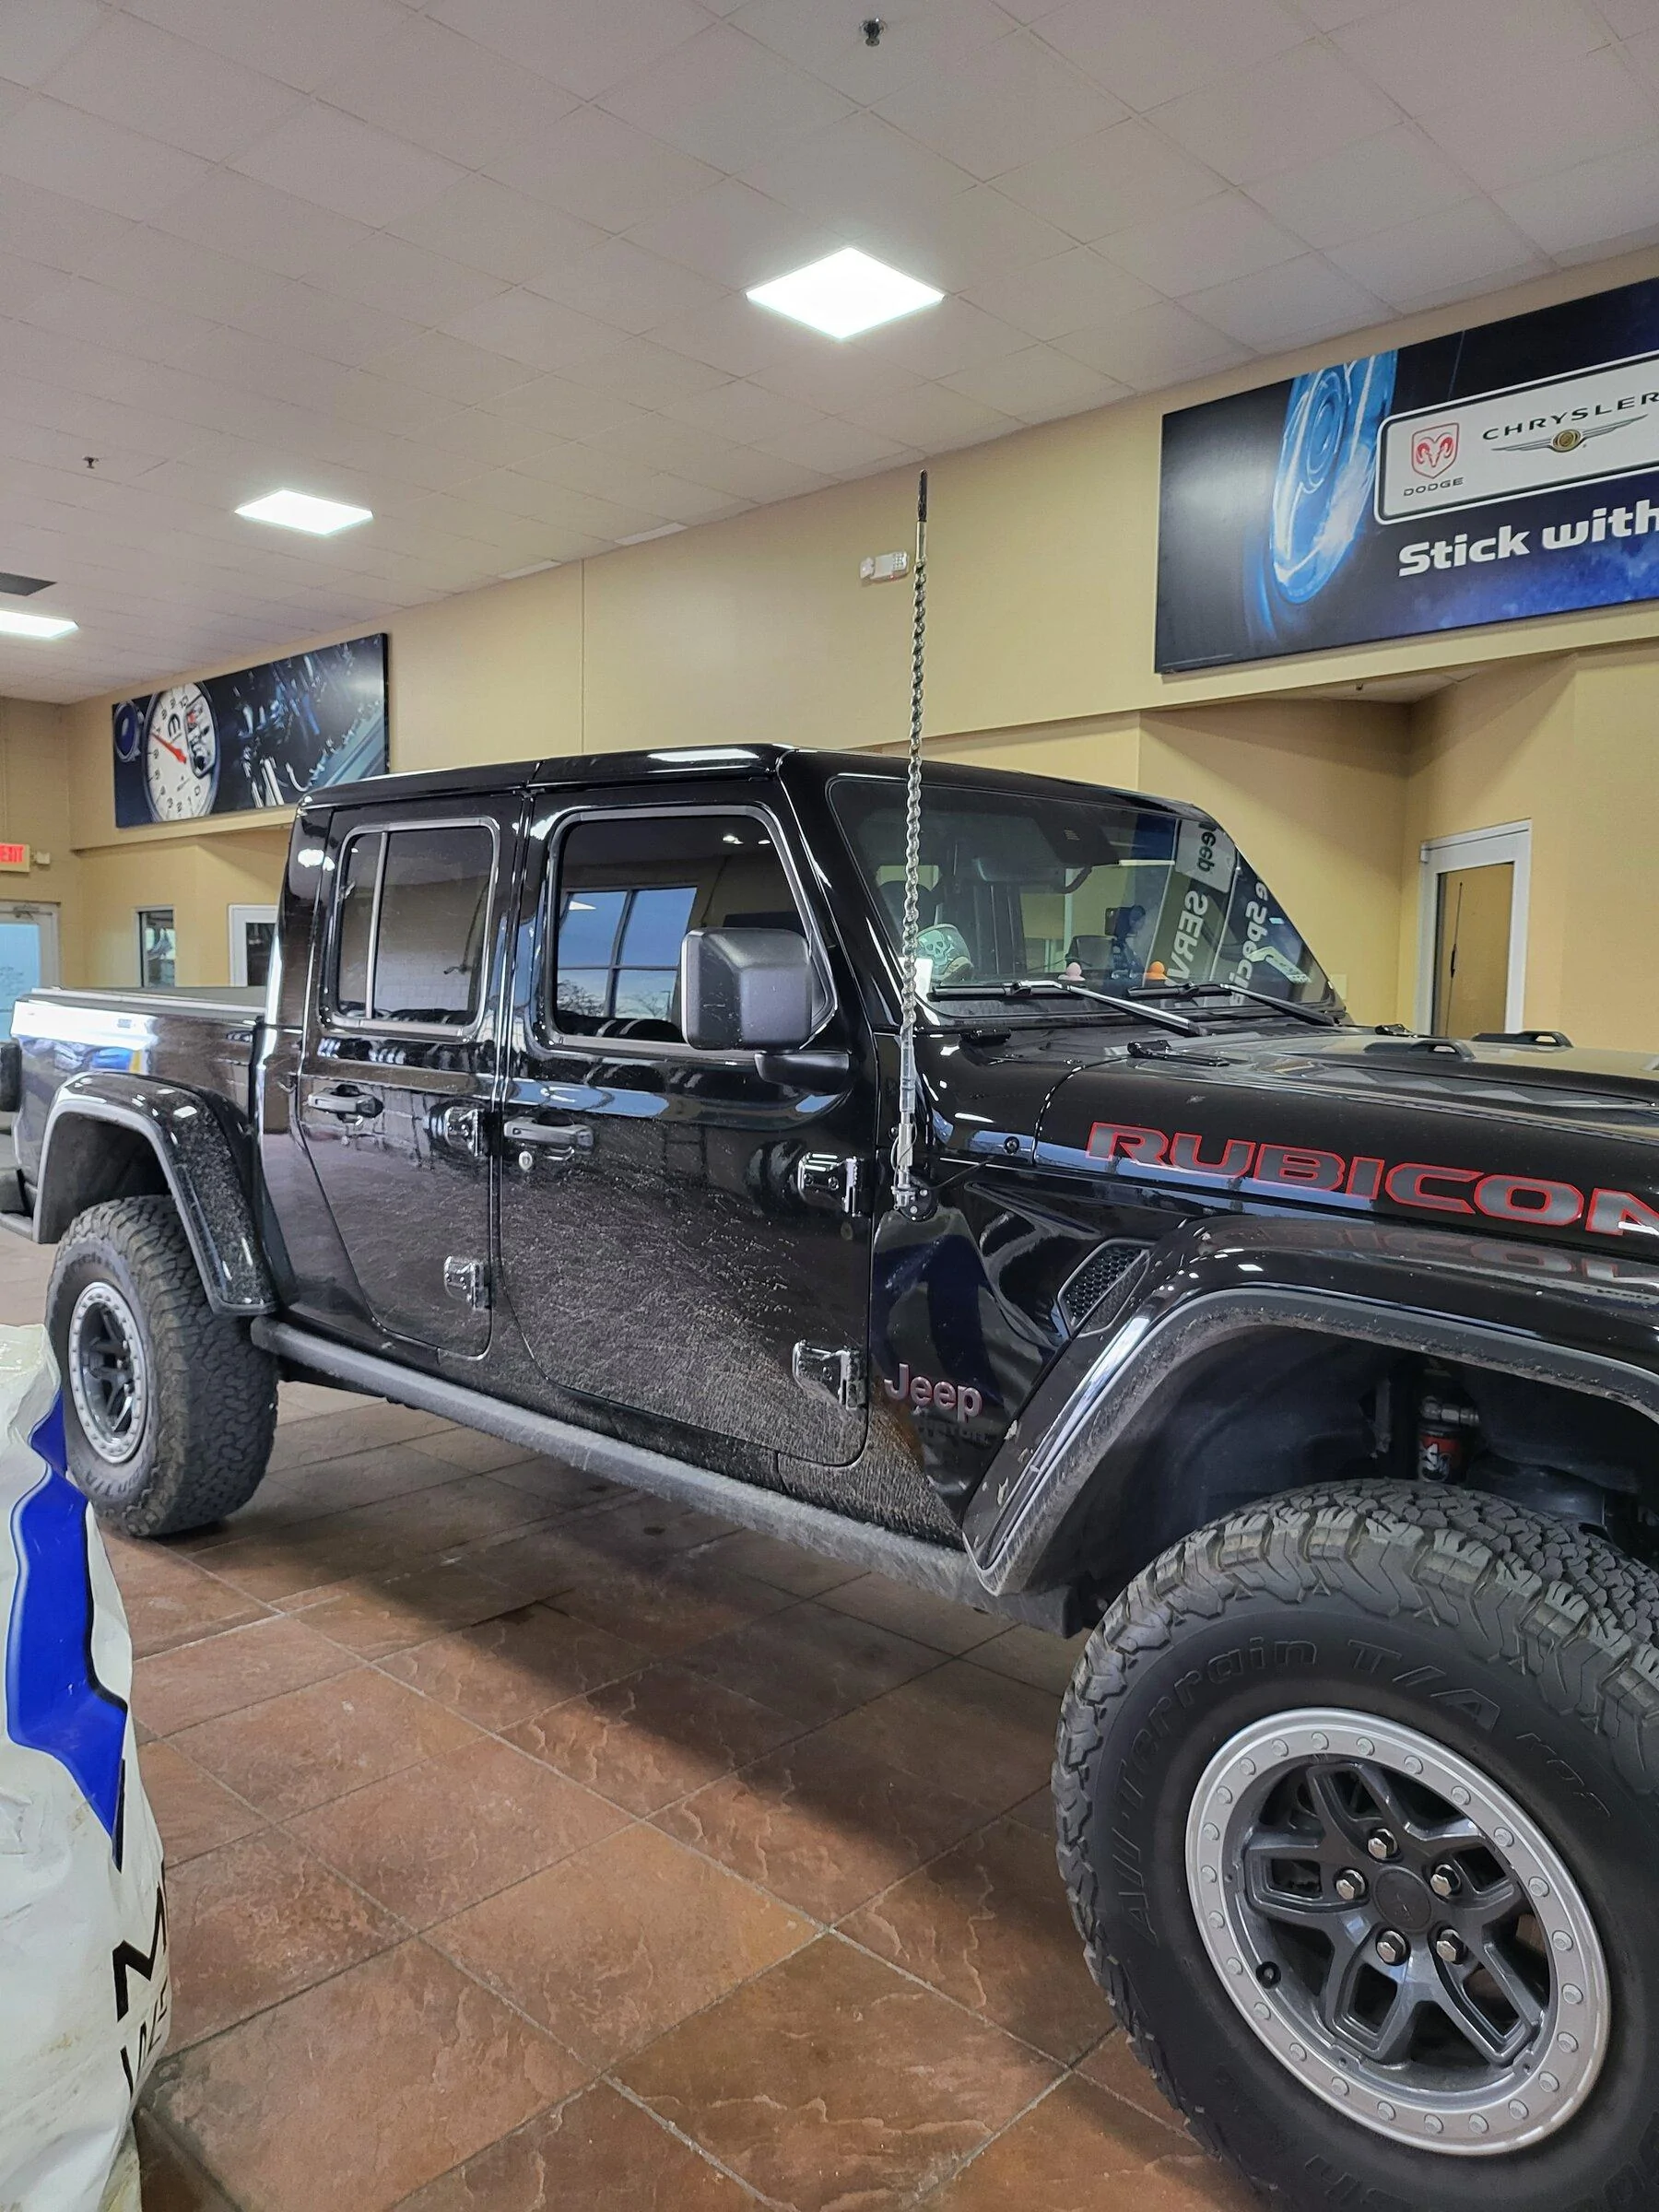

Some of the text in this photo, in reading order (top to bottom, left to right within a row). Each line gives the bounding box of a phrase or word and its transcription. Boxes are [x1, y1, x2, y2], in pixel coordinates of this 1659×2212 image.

[1482, 391, 1659, 441] CHRYSLER
[1403, 477, 1465, 497] DODGE
[1398, 499, 1659, 577] Stick with
[1086, 1122, 1659, 1236] RUBICON
[884, 1362, 983, 1424] Jeep
